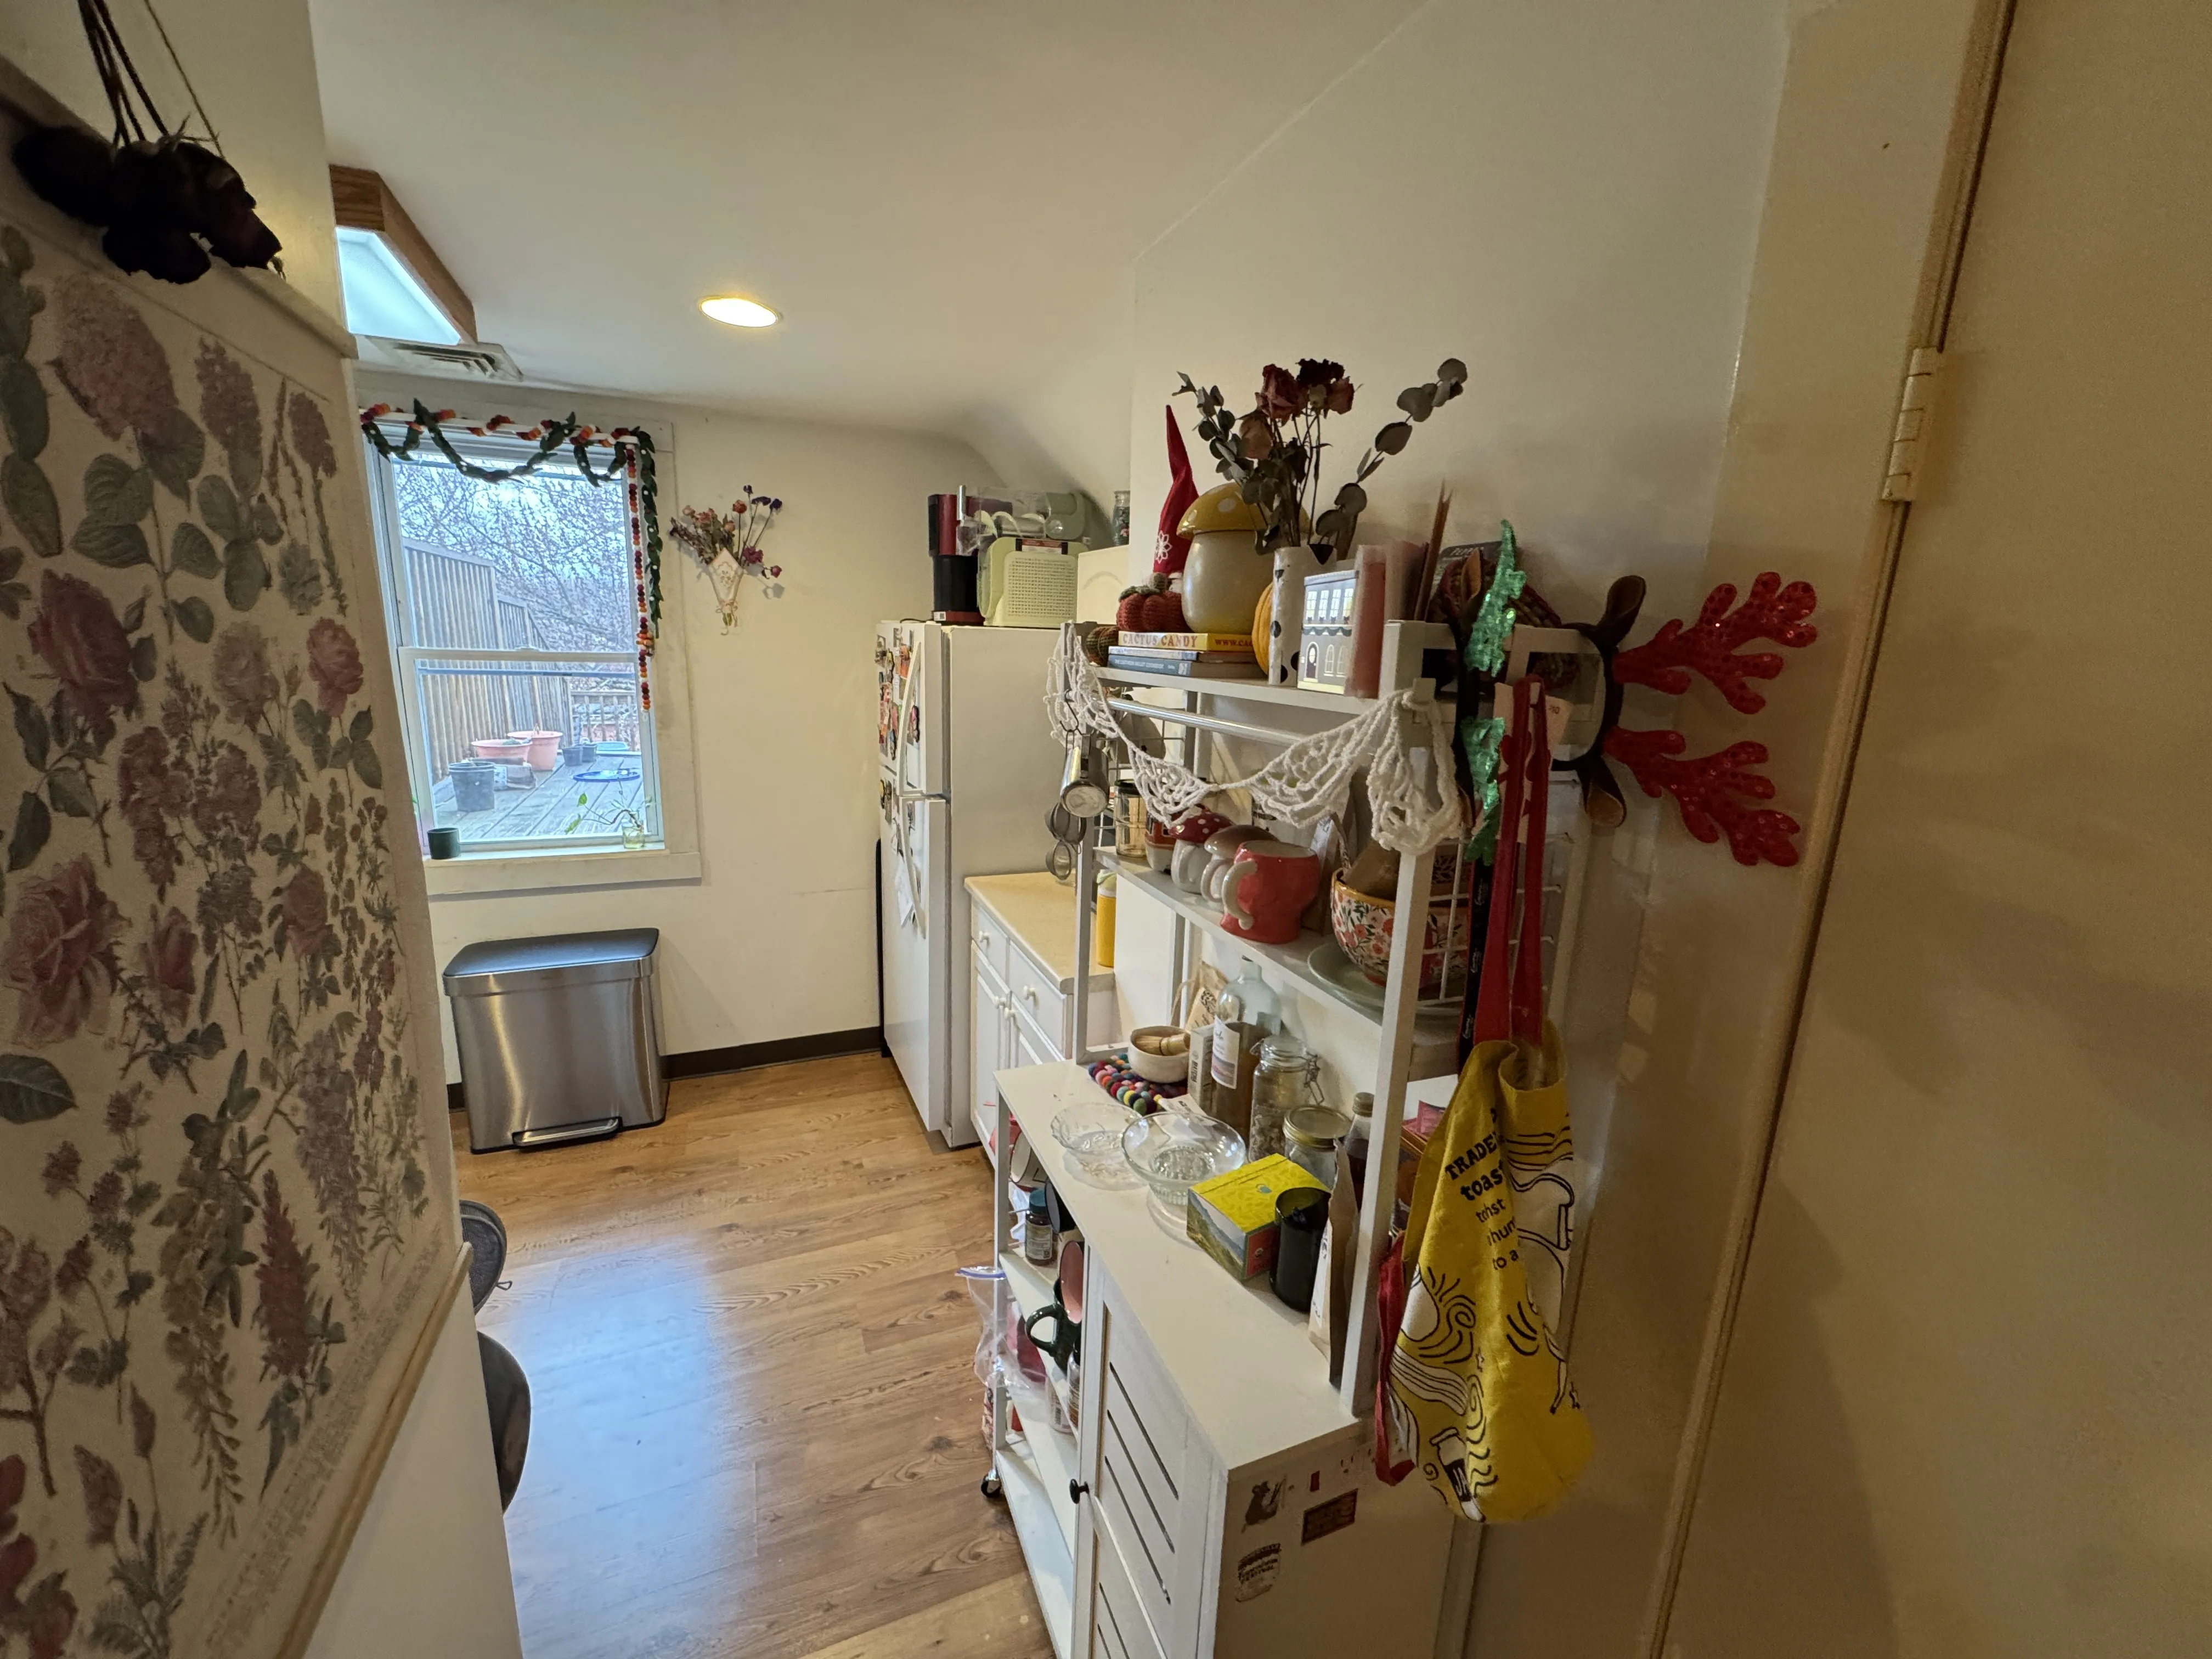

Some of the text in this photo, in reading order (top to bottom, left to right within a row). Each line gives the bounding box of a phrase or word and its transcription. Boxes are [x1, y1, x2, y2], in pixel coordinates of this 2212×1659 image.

[1122, 633, 1198, 648] CACTUS CANDY
[1445, 1131, 1498, 1180] TRADE
[1510, 1249, 1518, 1261] a
